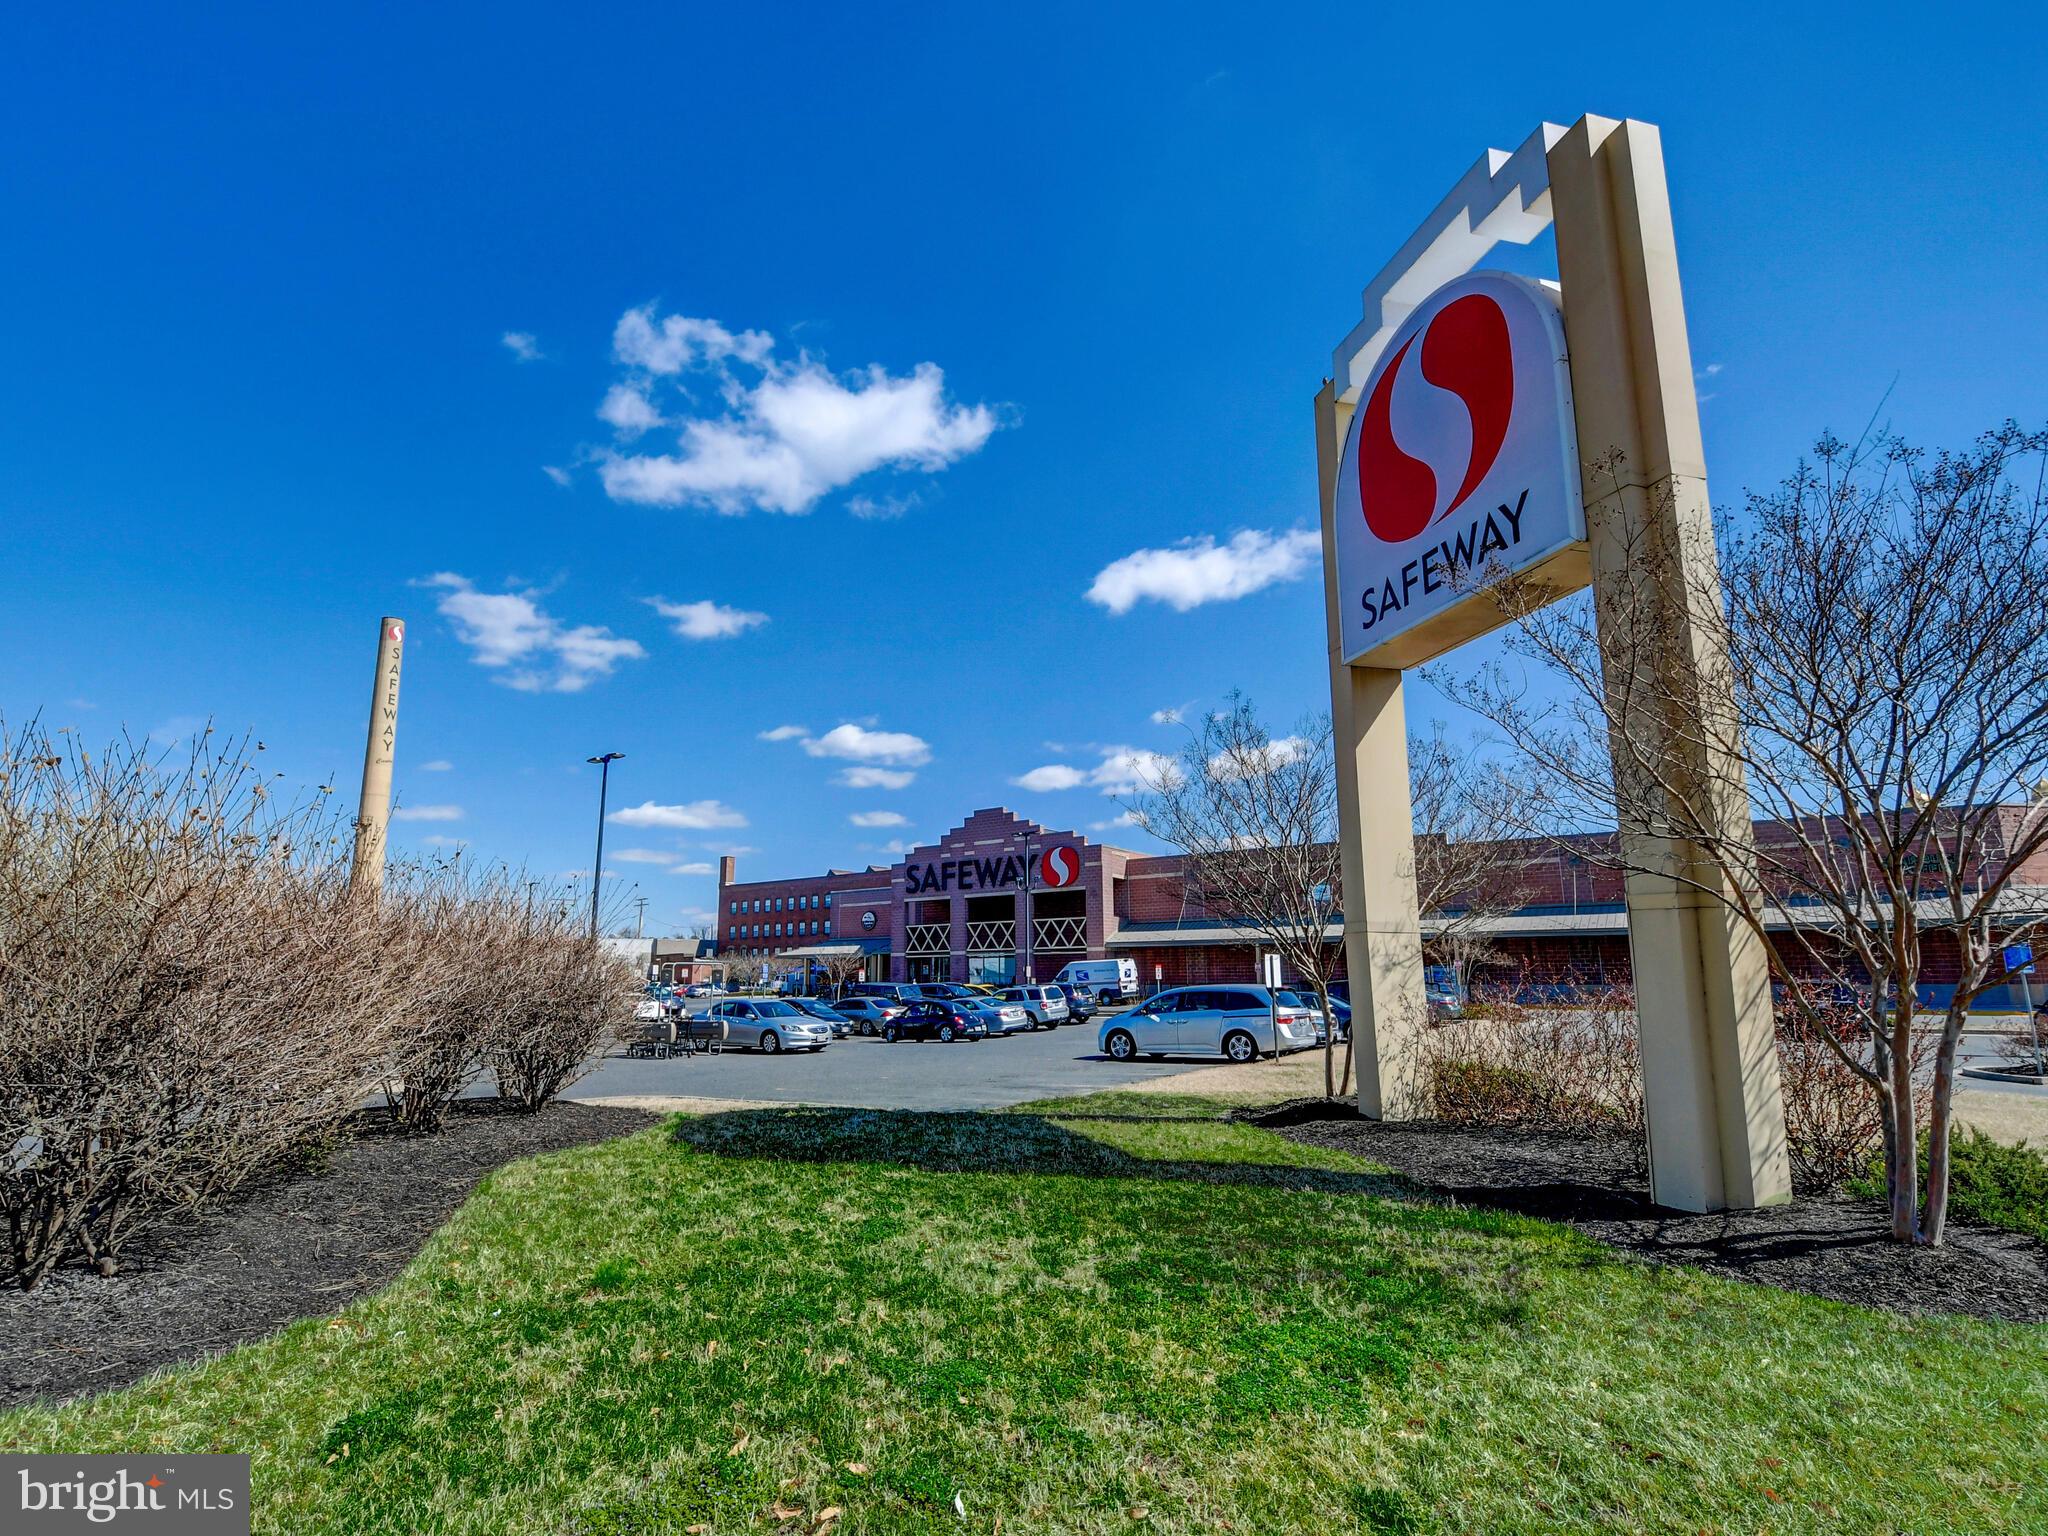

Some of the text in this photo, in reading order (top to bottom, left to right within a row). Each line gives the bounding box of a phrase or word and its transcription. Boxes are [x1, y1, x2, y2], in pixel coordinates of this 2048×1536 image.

[1361, 487, 1530, 630] SAFEWAY
[383, 647, 401, 752] SAFEWAY
[905, 853, 1040, 894] SAFEWAY
